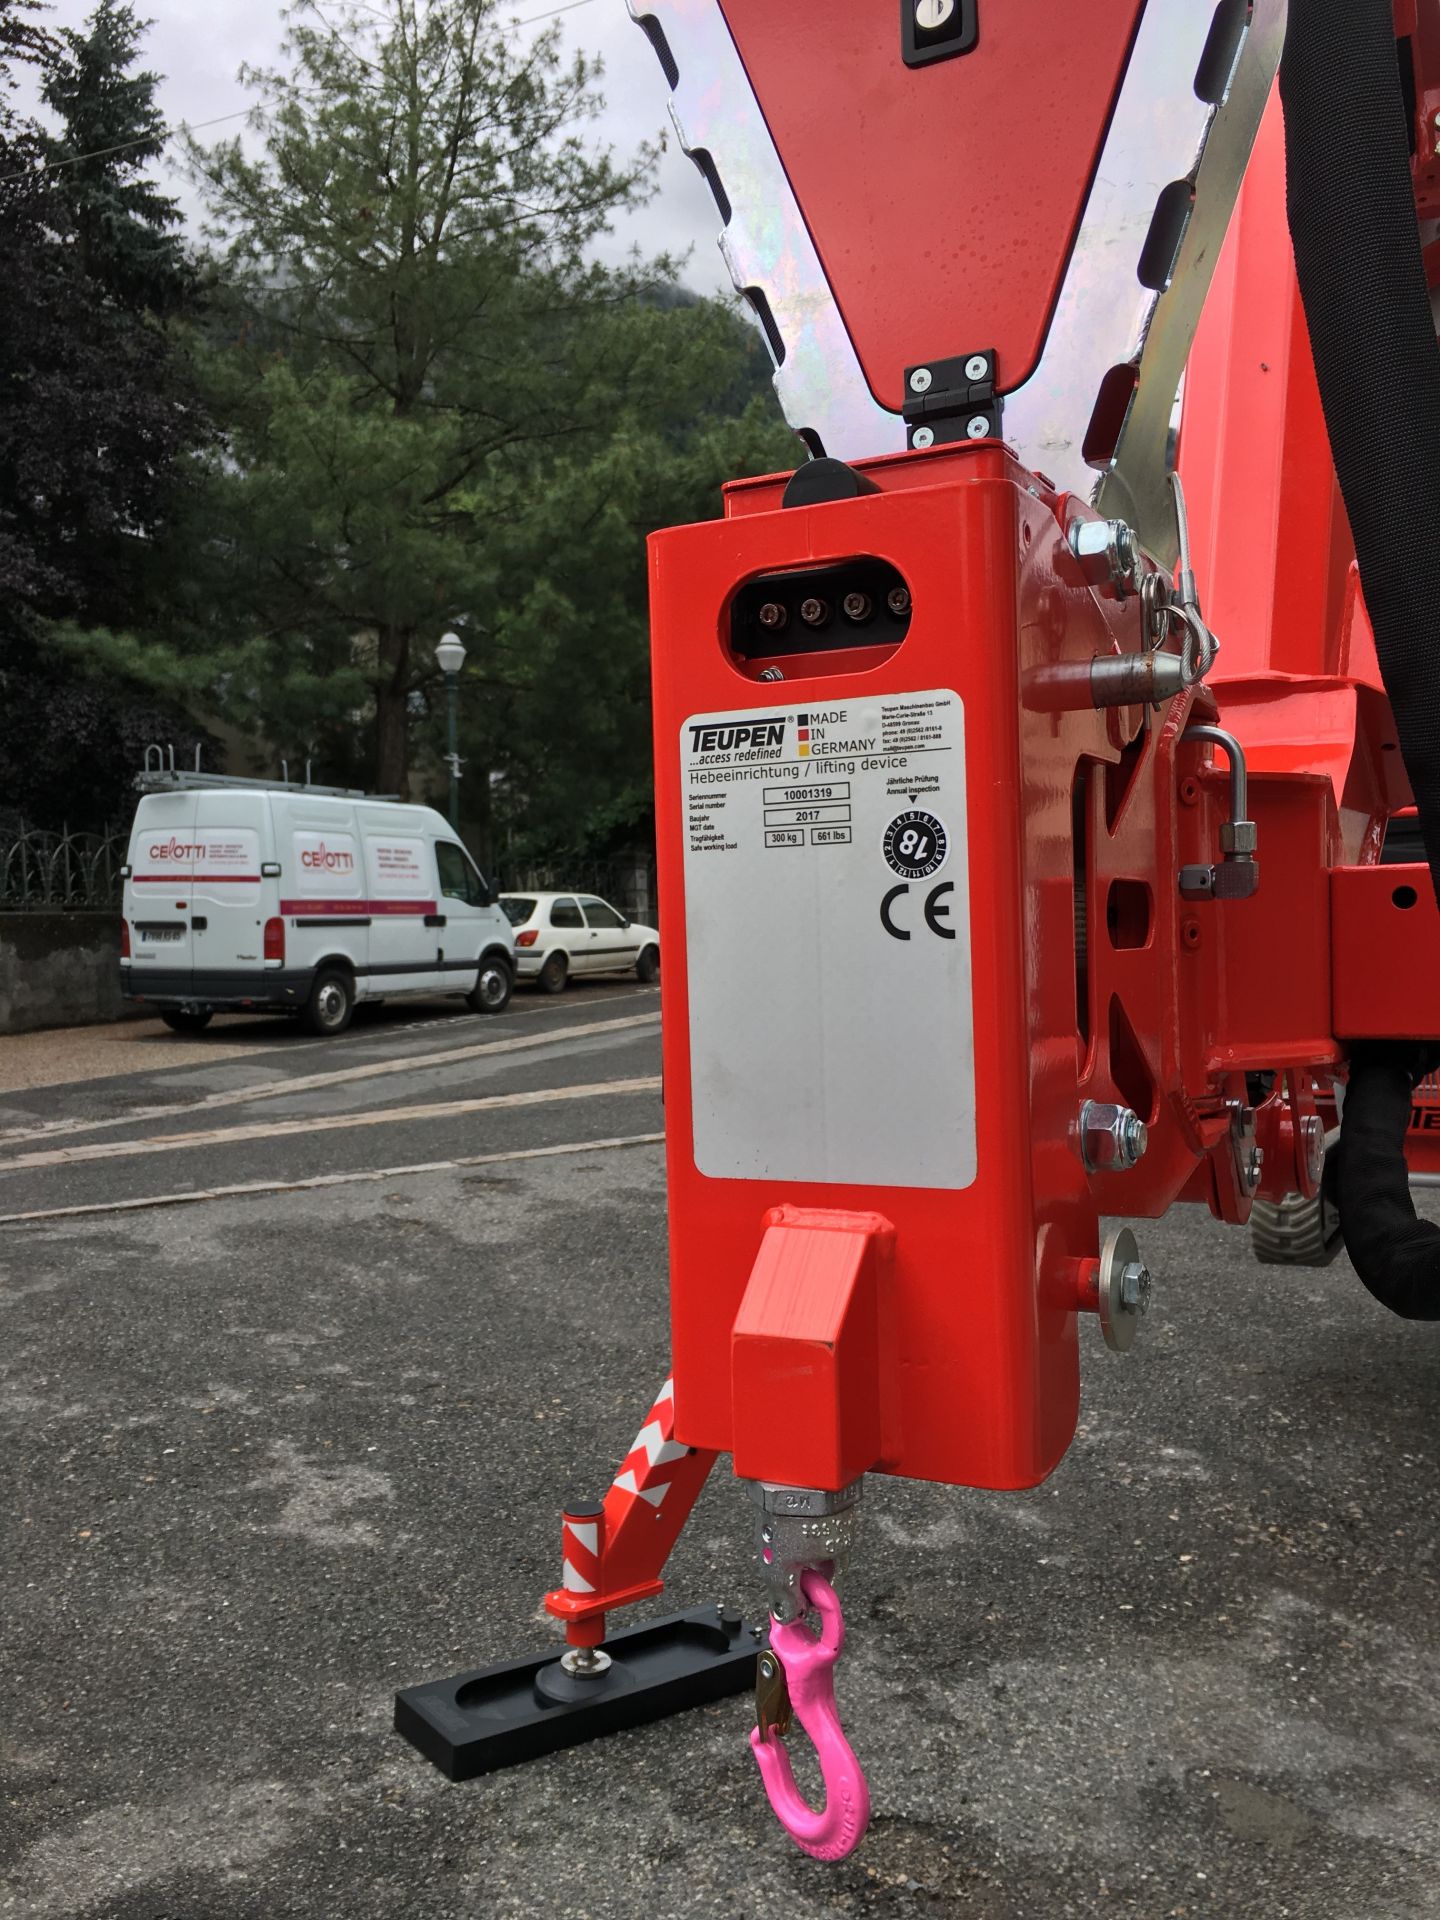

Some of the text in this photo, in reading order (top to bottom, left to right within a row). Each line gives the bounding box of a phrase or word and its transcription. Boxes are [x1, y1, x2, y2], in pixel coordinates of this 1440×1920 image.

[810, 711, 847, 724] MADE
[689, 717, 786, 752] TEUPEN
[811, 728, 825, 740] IN
[811, 738, 876, 755] GERMANY
[734, 746, 782, 761] redefined
[690, 756, 907, 784] Hebeeinrichtung / lifting device
[886, 775, 939, 785] Jährliche Prüfung
[784, 787, 832, 800] 10001319
[887, 785, 940, 795] Annual inspection
[689, 793, 727, 801] Seriennummer
[689, 815, 710, 823] Baujahr
[796, 811, 820, 821] 2017
[690, 834, 724, 843] Tragfähigkeit
[772, 833, 797, 843] 300 kg
[818, 831, 846, 841] 661 lbs
[704, 843, 725, 851] working
[899, 829, 928, 860] 18
[880, 881, 956, 940] CE
